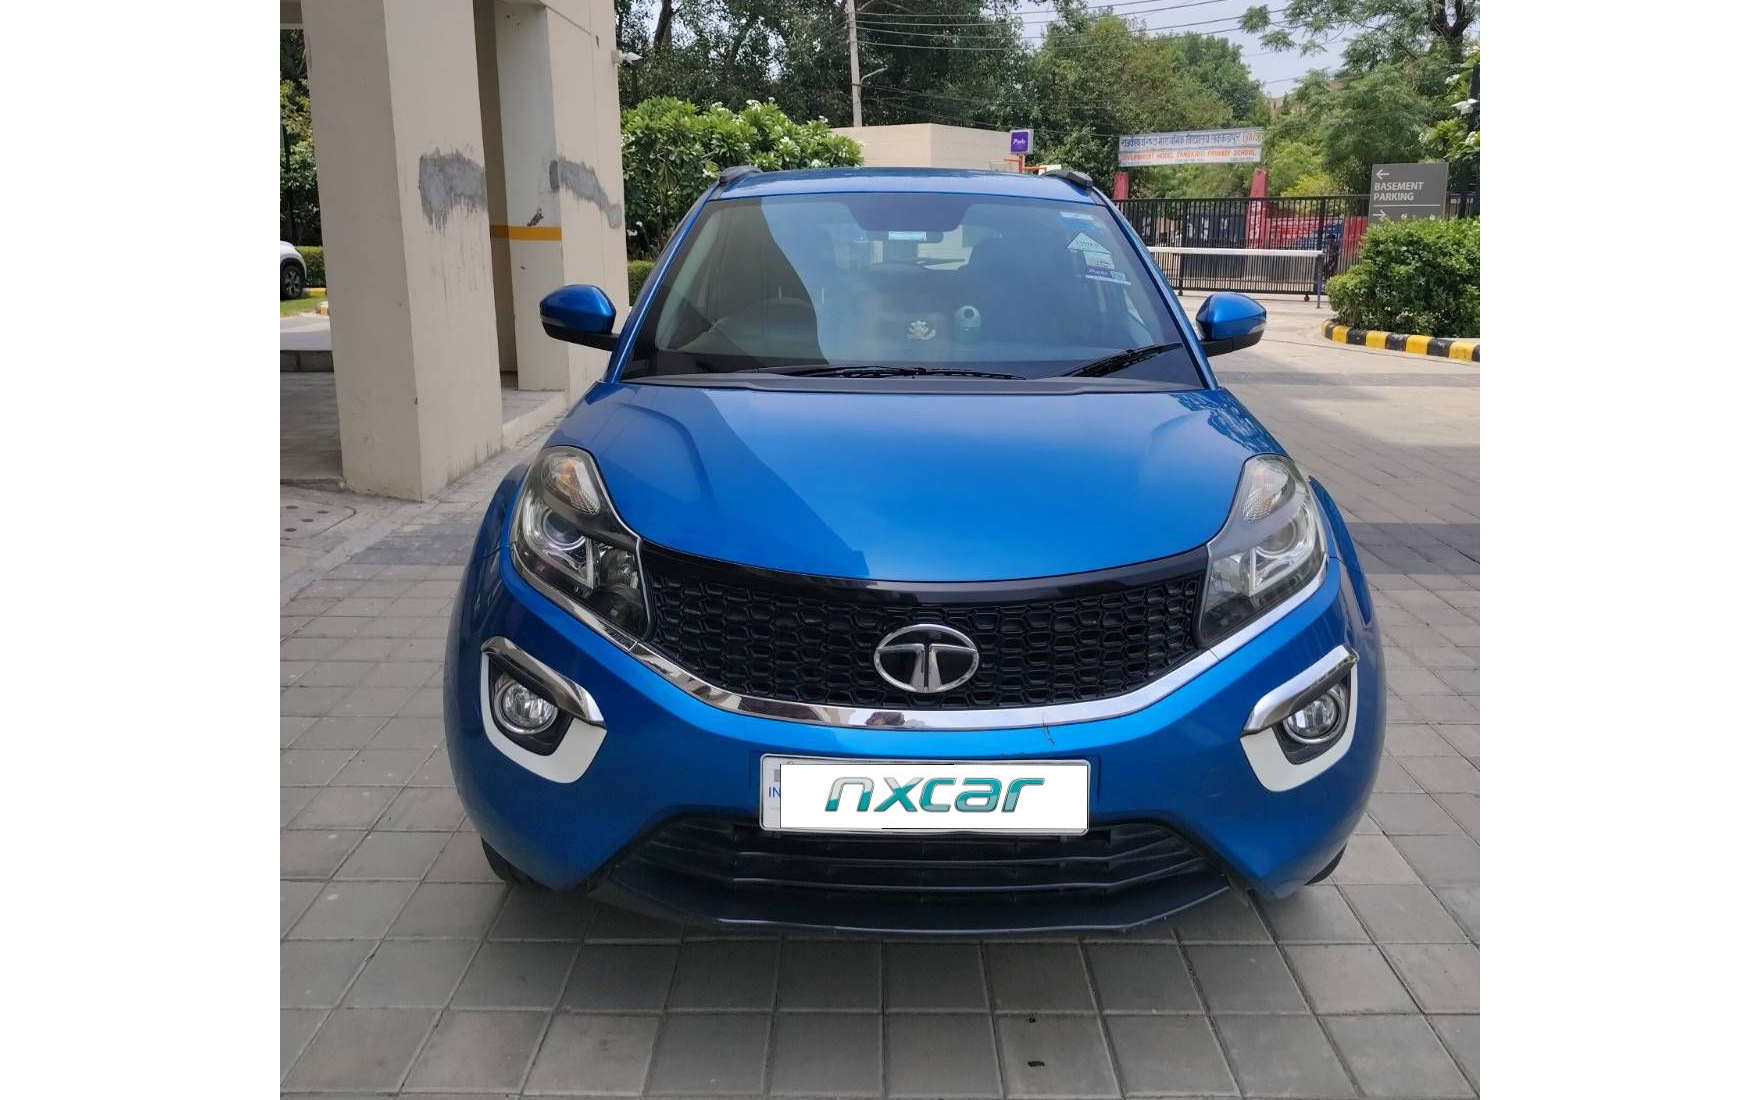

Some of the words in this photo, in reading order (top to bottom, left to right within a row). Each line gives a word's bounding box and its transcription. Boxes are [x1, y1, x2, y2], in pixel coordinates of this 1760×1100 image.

[1233, 148, 1257, 157] SCHOOL
[1374, 182, 1424, 191] BASEMENT
[1373, 192, 1415, 201] PARKING
[768, 786, 781, 798] IN
